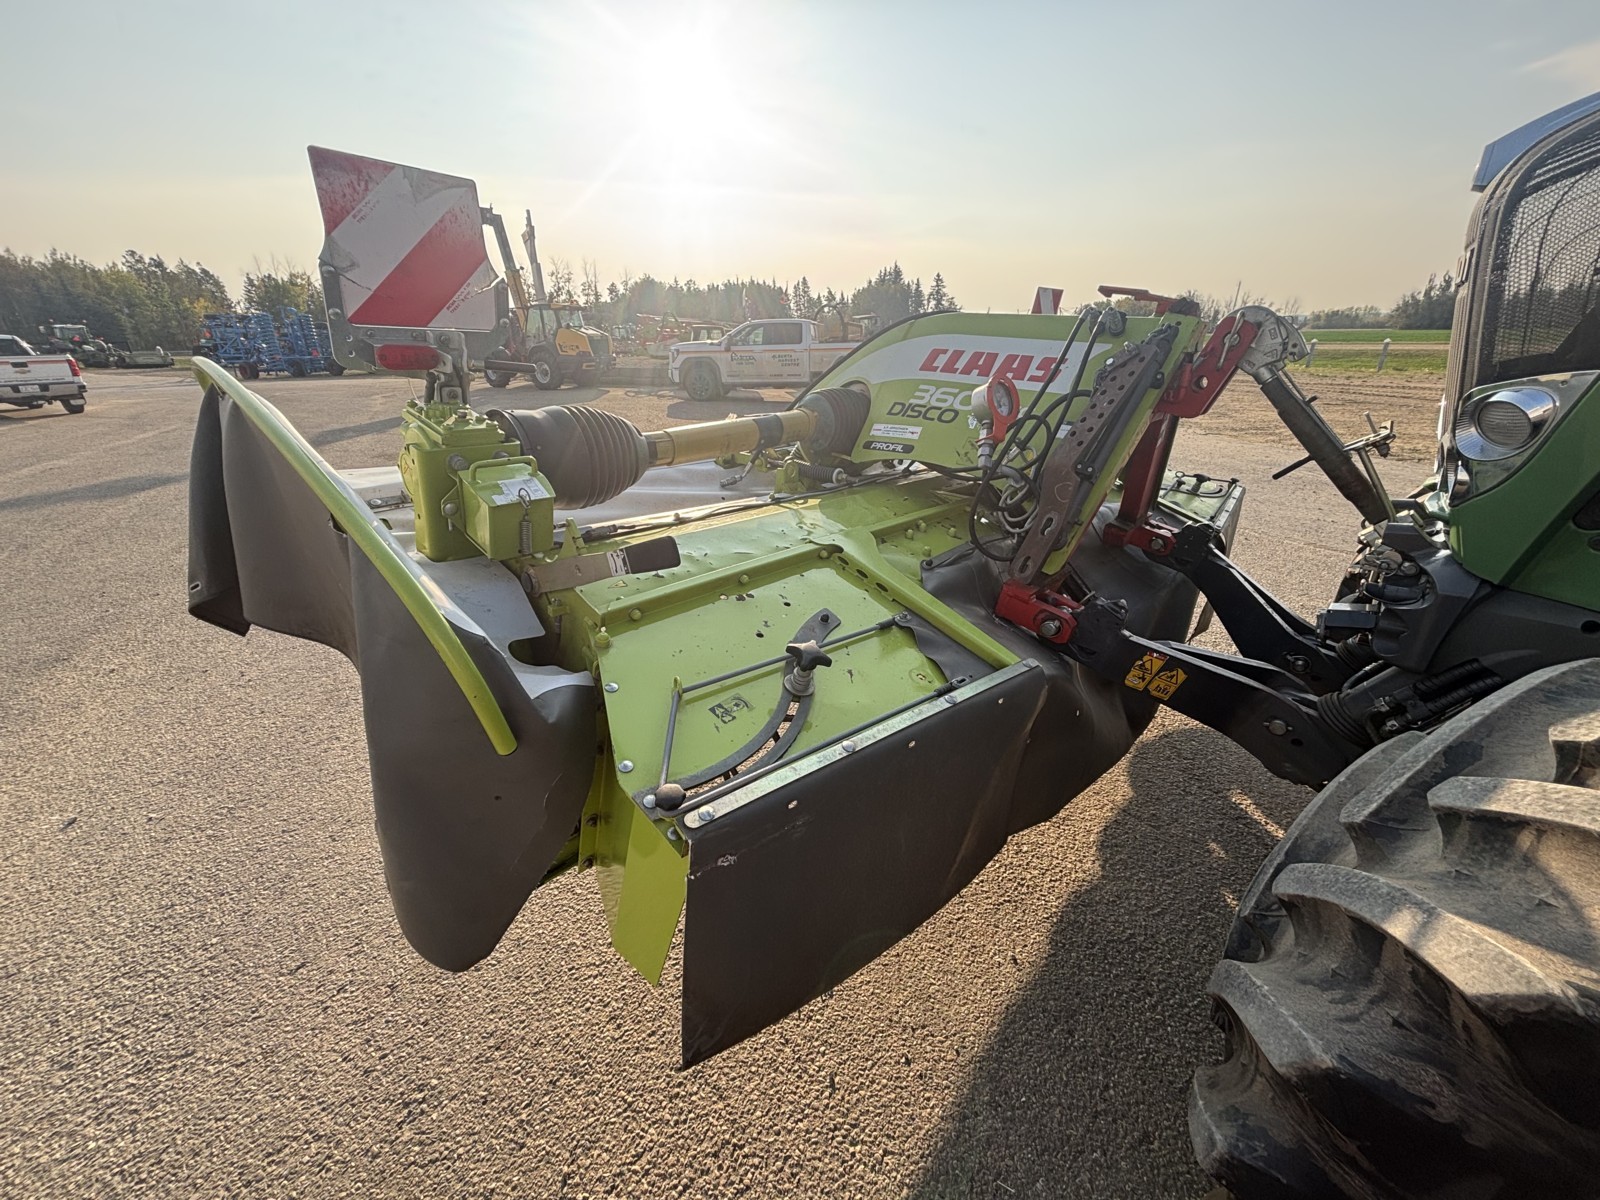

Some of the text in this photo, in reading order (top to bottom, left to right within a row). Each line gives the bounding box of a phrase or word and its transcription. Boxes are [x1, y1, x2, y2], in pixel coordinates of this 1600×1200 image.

[918, 347, 1068, 383] CLAAS
[908, 384, 973, 411] 360
[886, 401, 960, 424] DISCO
[870, 441, 904, 452] PROFIL
